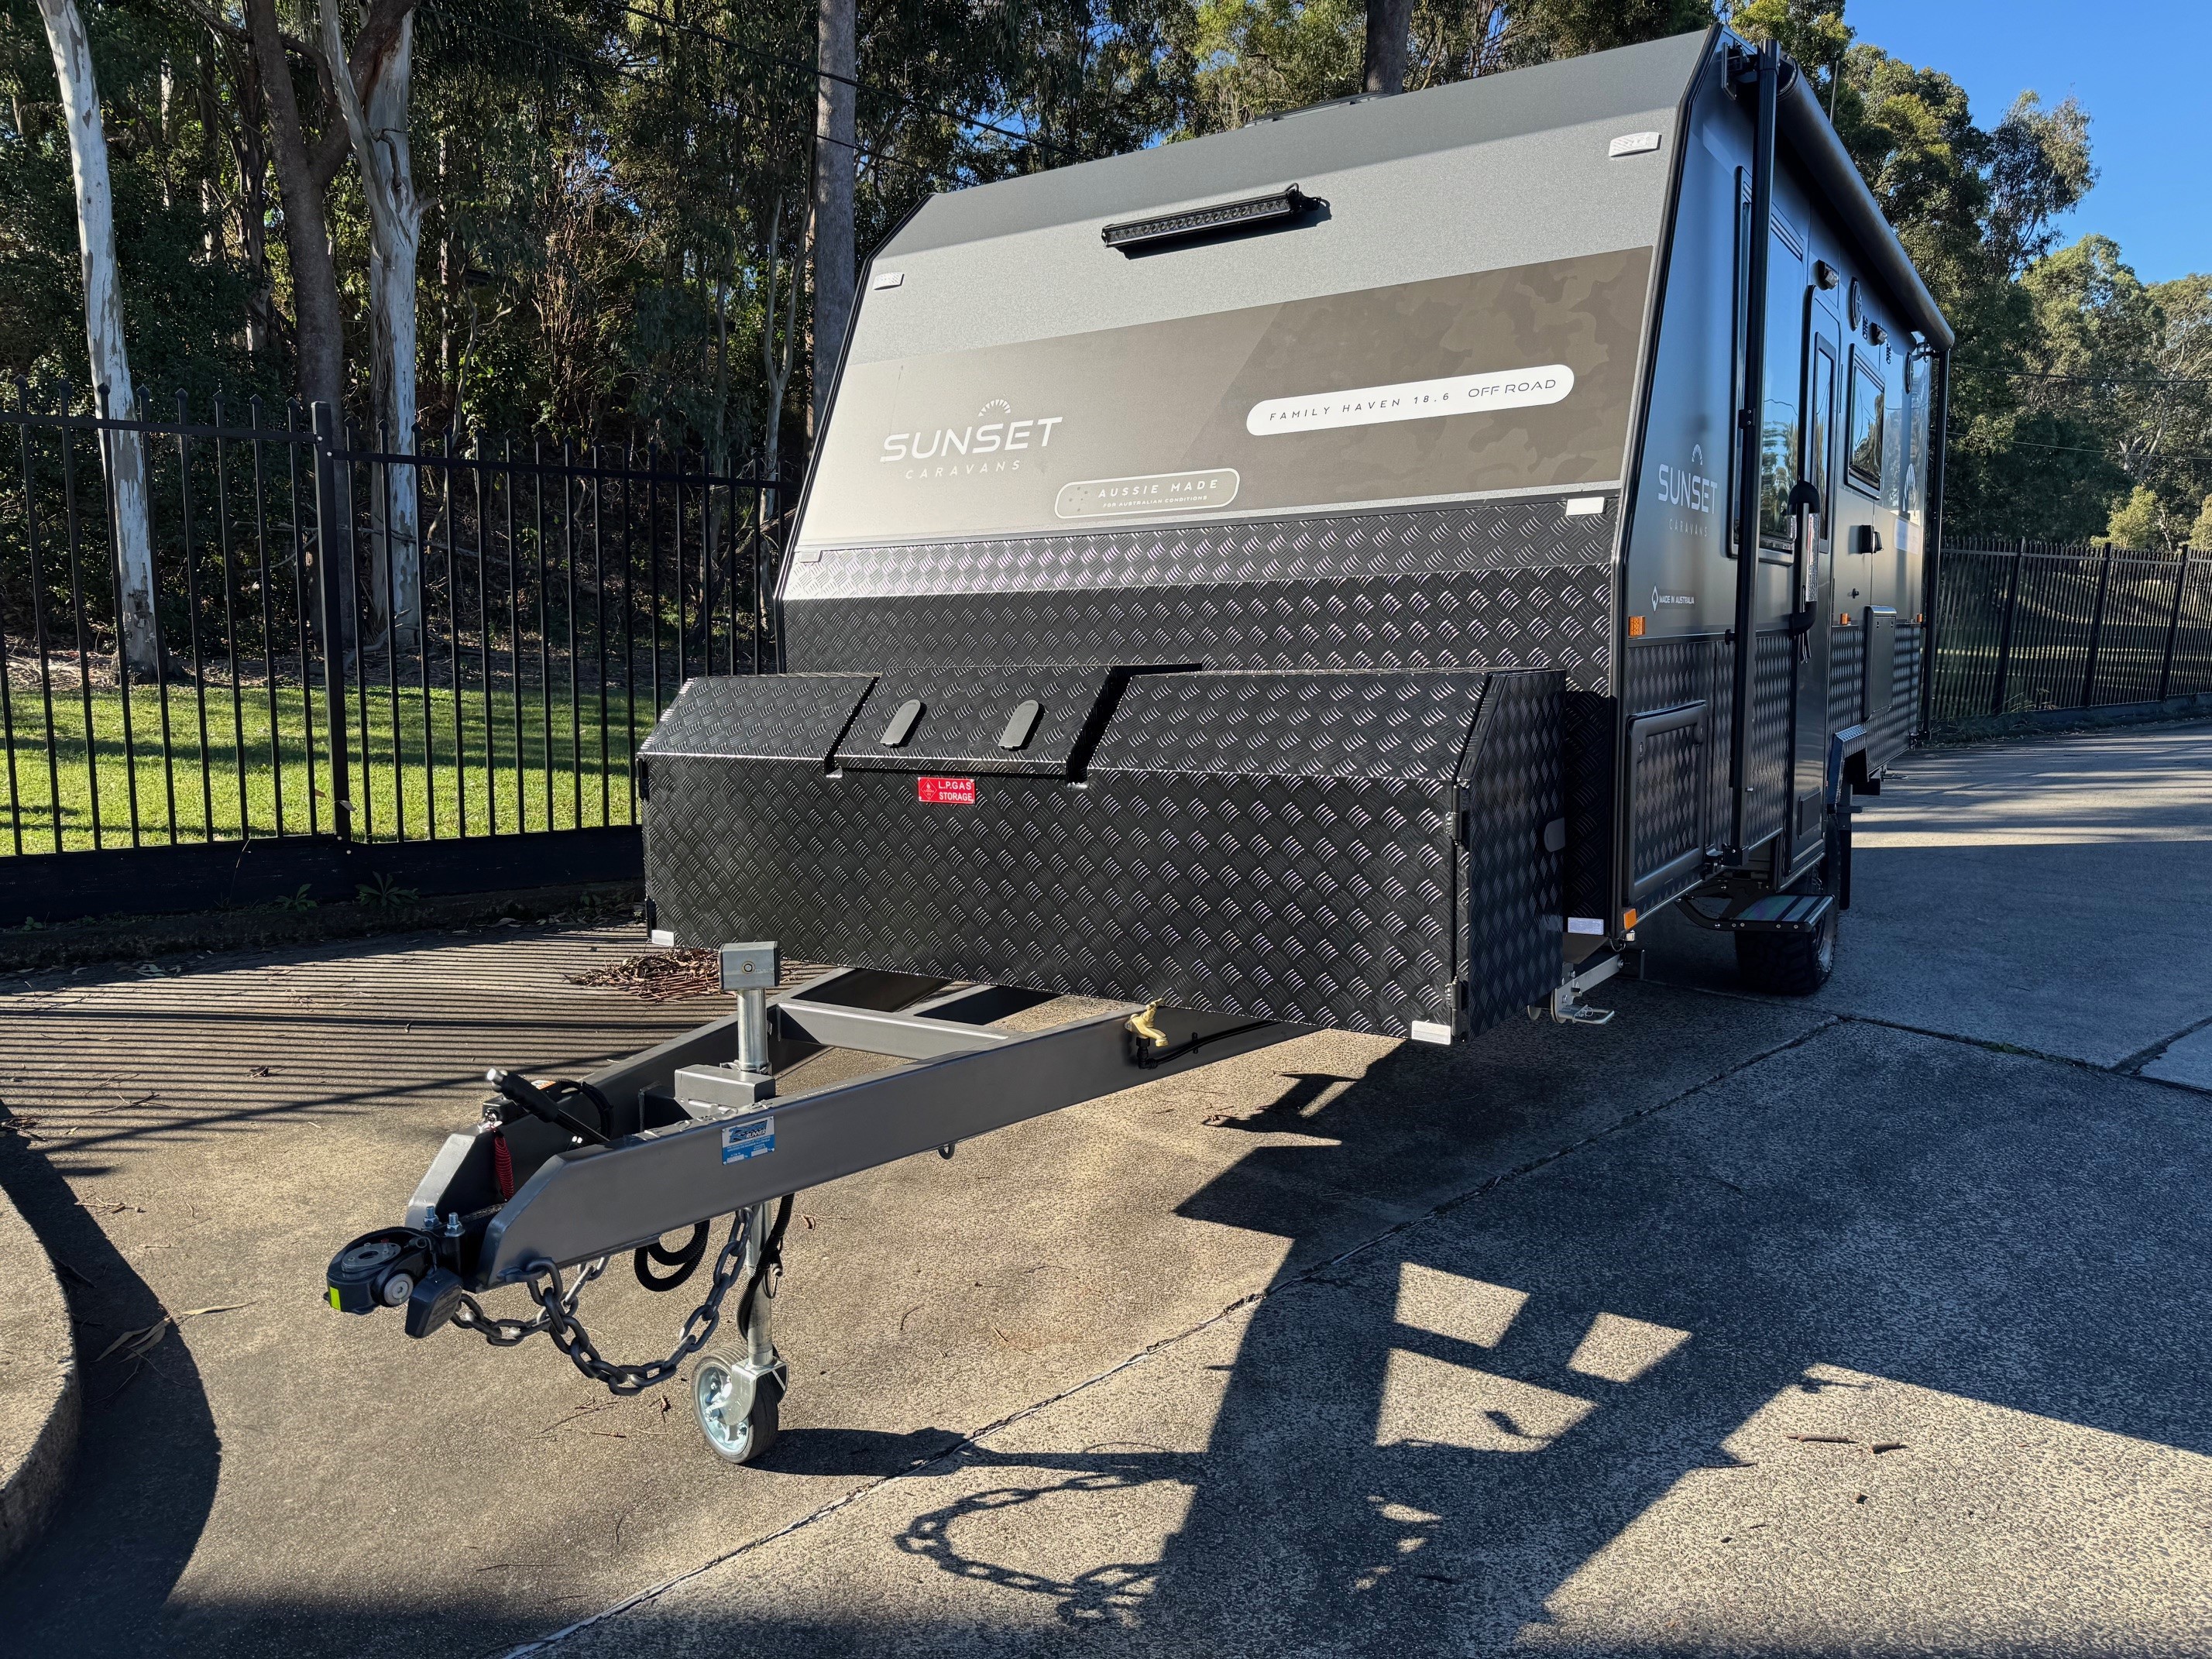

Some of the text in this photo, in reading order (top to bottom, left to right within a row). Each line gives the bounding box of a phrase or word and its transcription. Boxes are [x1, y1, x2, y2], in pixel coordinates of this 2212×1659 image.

[1269, 379, 1556, 421] FAMILY HAVEN 18.6 OFF ROAD
[880, 417, 1063, 462] SUNSET
[905, 459, 1021, 479] CARAVANS
[1098, 479, 1218, 498] AUSSIE MADE
[1657, 463, 1718, 514] SUNSET
[1118, 499, 1163, 507] AUSTRALIAN
[1164, 495, 1208, 503] CONDITIONS
[1669, 518, 1708, 538] CARAVANS
[1659, 595, 1671, 603] MADE
[1675, 596, 1695, 604] AUSTRALIA
[939, 792, 974, 802] STORAGE
